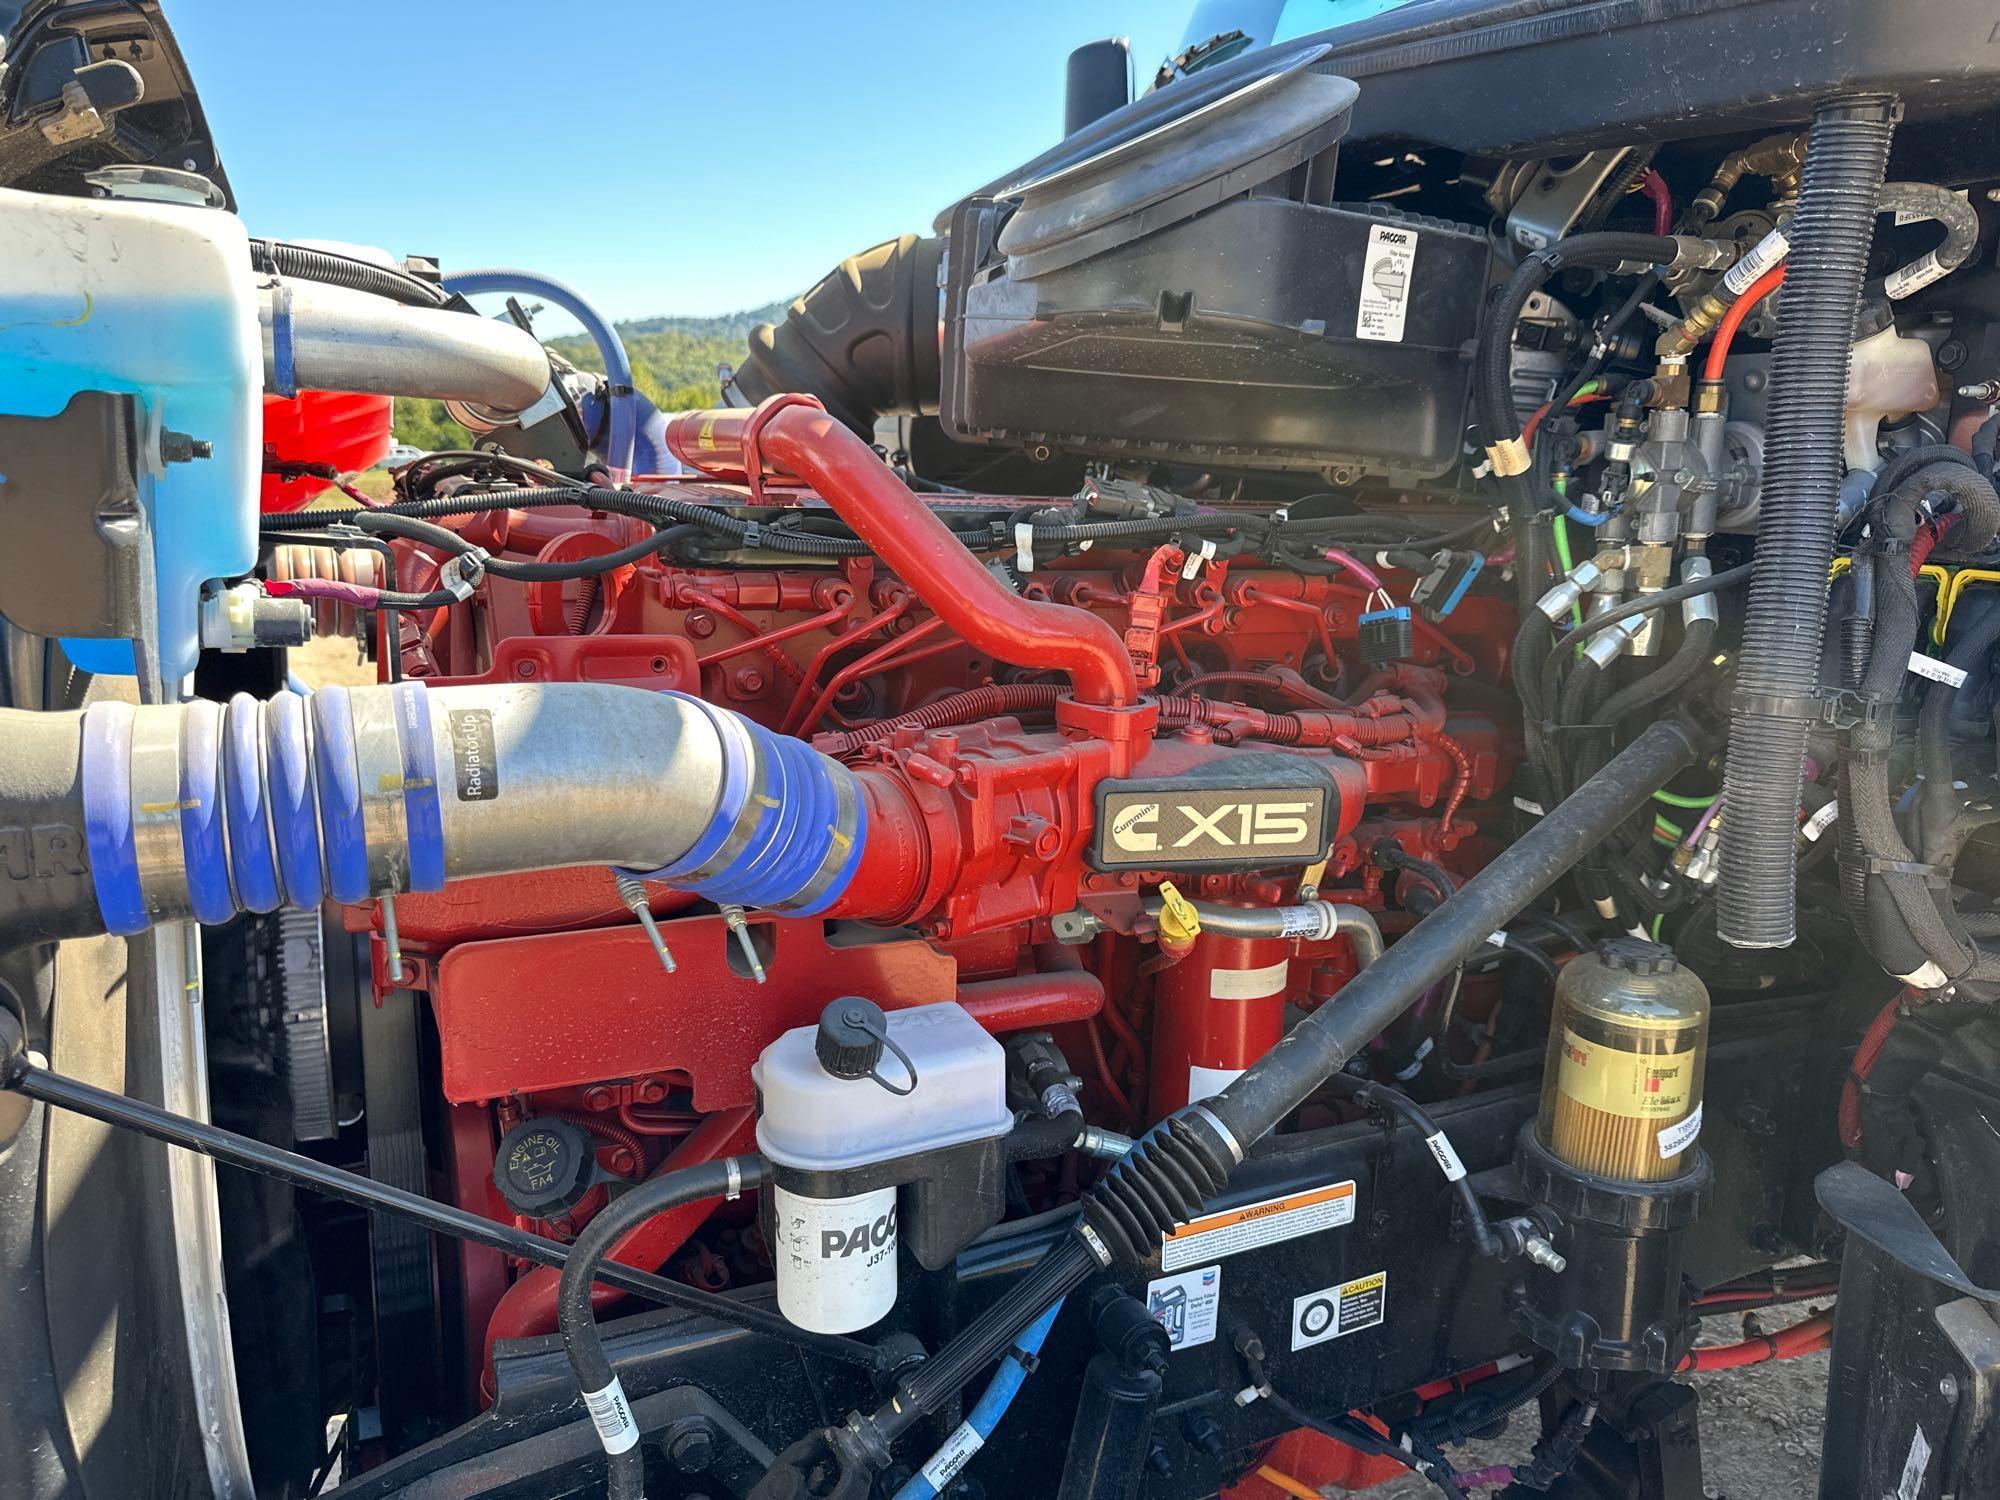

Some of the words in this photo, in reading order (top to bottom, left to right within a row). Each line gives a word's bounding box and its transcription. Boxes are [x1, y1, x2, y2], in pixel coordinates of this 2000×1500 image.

[1380, 230, 1408, 246] PACCAR
[461, 714, 480, 733] Up
[465, 733, 482, 797] Radiator
[1113, 804, 1156, 835] Cummins
[1172, 802, 1309, 848] X15
[509, 1134, 545, 1170] ENGINE
[545, 1136, 561, 1154] OIL
[1431, 1139, 1452, 1170] PACCAR
[531, 1173, 554, 1190] FA4
[1244, 1202, 1286, 1219] WARNING
[1348, 1276, 1384, 1293] CAUTION
[612, 1395, 630, 1430] PACCAR
[939, 1449, 965, 1477] PACCAR
